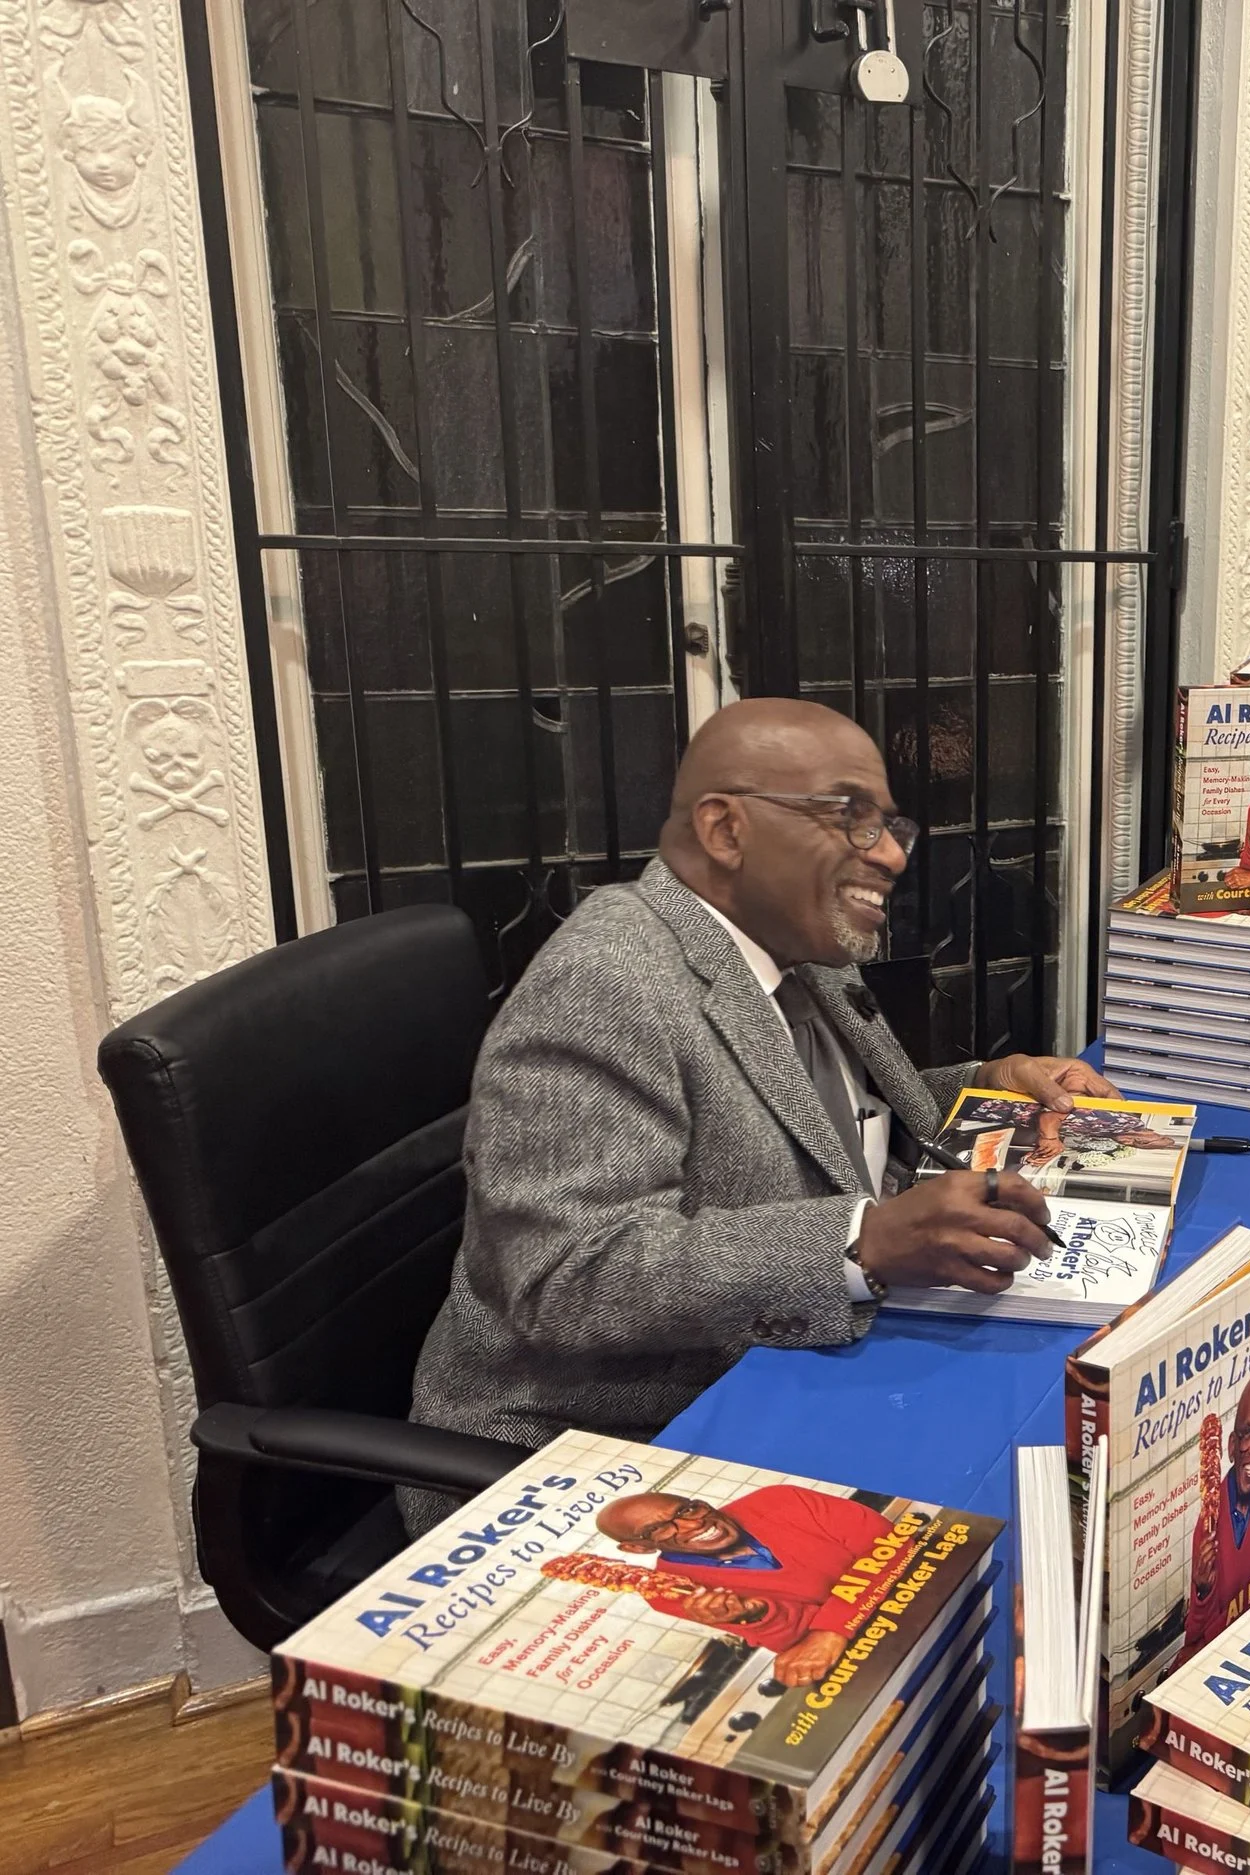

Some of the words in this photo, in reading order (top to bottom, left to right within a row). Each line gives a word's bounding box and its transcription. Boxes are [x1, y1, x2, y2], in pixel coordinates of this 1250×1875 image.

[1206, 703, 1231, 724] Al
[1202, 787, 1222, 795] Family
[1202, 808, 1232, 816] Occasion
[1197, 891, 1214, 901] with
[1075, 1216, 1097, 1231] Al
[1029, 1268, 1052, 1282] By
[1056, 1233, 1092, 1280] Roker's
[1134, 1360, 1167, 1417] Al
[1133, 1389, 1202, 1459] Recipes
[1206, 1376, 1223, 1405] to
[1133, 1488, 1155, 1510] Easy,
[1133, 1473, 1199, 1531] Memory-Making
[1133, 1523, 1160, 1551] Family
[1161, 1501, 1189, 1527] Dishes
[355, 1591, 426, 1638] Al
[406, 1473, 577, 1589] Roker's
[400, 1563, 516, 1652] Recipes
[511, 1540, 545, 1563] to
[535, 1491, 605, 1540] Live
[593, 1463, 643, 1493] By
[831, 1574, 872, 1604] Al
[852, 1512, 924, 1574] Roker
[844, 1611, 865, 1631] New
[861, 1595, 880, 1617] York
[875, 1574, 897, 1602] Times
[893, 1540, 928, 1576] bestselling
[924, 1519, 943, 1547] author
[1133, 1552, 1147, 1574] for
[1147, 1534, 1171, 1559] Every
[1133, 1553, 1172, 1590] Occasion
[501, 1589, 600, 1672] Memory-Making
[1226, 1593, 1244, 1626] Al
[478, 1638, 518, 1666] Easy,
[526, 1638, 572, 1679] Family
[563, 1606, 607, 1640] Dishes
[785, 1709, 819, 1746] with
[805, 1615, 899, 1709] Courtney
[880, 1561, 937, 1615] Roker
[925, 1522, 970, 1561] Laga
[554, 1664, 574, 1685] for
[569, 1634, 609, 1667] Every
[576, 1638, 635, 1689] Occasion
[302, 1678, 326, 1701] Al
[332, 1685, 416, 1725] Roker's
[421, 1709, 483, 1743] Recipes
[485, 1727, 503, 1746] to
[506, 1732, 548, 1759] Live
[551, 1742, 577, 1768] By
[1164, 1730, 1185, 1752] Al
[609, 1769, 665, 1795] Courtney
[667, 1782, 704, 1802] Roker
[705, 1793, 735, 1812] Laga
[629, 1759, 646, 1773] Al
[649, 1764, 695, 1786] Roker
